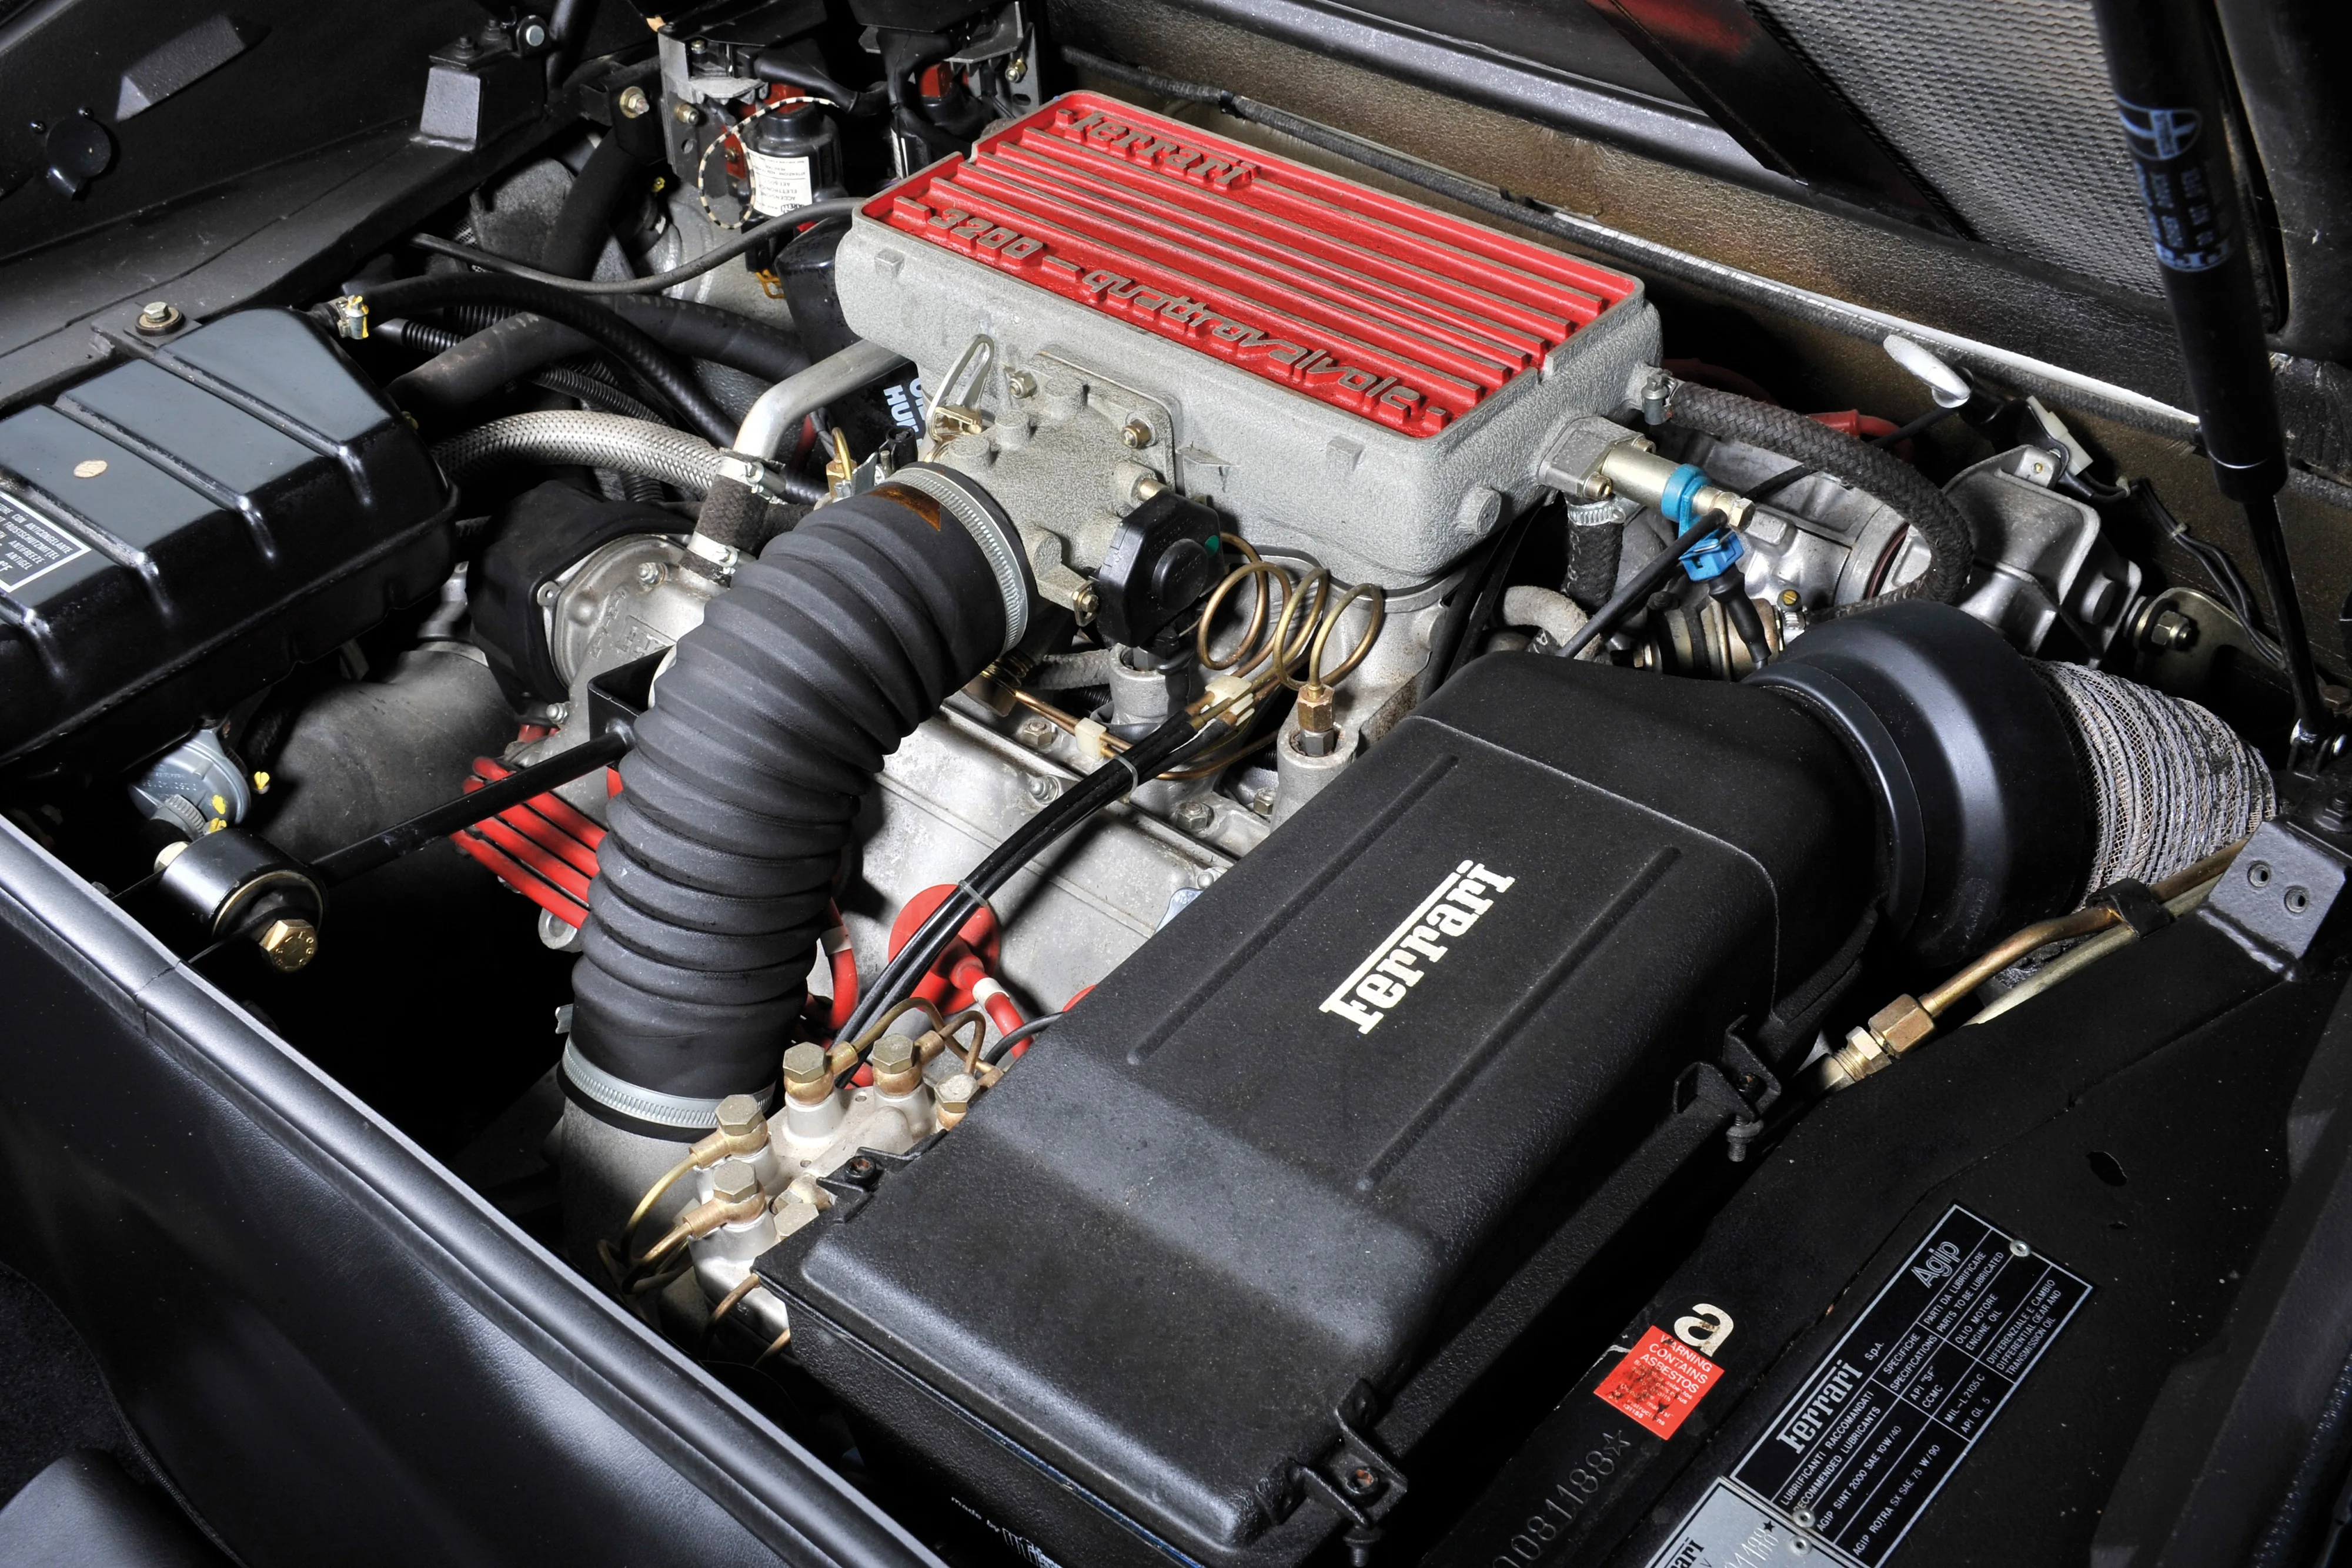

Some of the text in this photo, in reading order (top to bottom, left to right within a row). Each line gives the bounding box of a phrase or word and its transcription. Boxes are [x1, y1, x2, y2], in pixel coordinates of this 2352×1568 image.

[1067, 110, 1257, 185] Ferrari
[927, 208, 1421, 410] 3200 quattrovalvole
[5, 551, 33, 570] ANTIGEL
[8, 540, 45, 564] ANTIFREEZE
[1318, 860, 1516, 1035] Ferrari
[1923, 1252, 1986, 1325] PARTI DA LUBRIFICARE
[1936, 1252, 2004, 1332] PARTS TO BE LUBRICATED
[1955, 1293, 1997, 1344] OLIO MOTORE
[1966, 1310, 2002, 1350] ENGINE OIL
[1986, 1314, 2029, 1364] DIFFERENZIALE
[2031, 1279, 2055, 1306] CAMBIO
[1996, 1290, 2061, 1370] DIFFERENTIAL GEAR AND
[1640, 1353, 1699, 1394] ASBESTOS
[1649, 1343, 1708, 1385] CONTAINS
[1659, 1334, 1713, 1373] WARNING
[1776, 1359, 1863, 1455] Ferrari
[1911, 1241, 1960, 1288] Agip
[1883, 1333, 1920, 1375] SPECIFICHE
[1886, 1335, 1937, 1395] SPECIFICATIONS
[2005, 1318, 2056, 1375] TRANSMISSION OIL
[1664, 1379, 1693, 1400] asbetos
[1910, 1385, 1925, 1400] API
[1922, 1385, 1943, 1407] CCMC
[1840, 1406, 1881, 1454] LUBRICANTS
[1961, 1419, 1974, 1433] API
[1971, 1407, 1983, 1417] GL
[1780, 1390, 1874, 1506] LUBRIFICANTI RACCOMANDATI
[1816, 1510, 1833, 1532] AGIP
[1833, 1489, 1852, 1509] SINT
[1849, 1469, 1867, 1490] 2000
[1863, 1453, 1880, 1470] SAE
[1853, 1534, 1869, 1556] AGIP
[1869, 1507, 1893, 1533] ROTRA
[1890, 1495, 1902, 1505] SX
[1899, 1480, 1914, 1495] SAE
[1912, 1469, 1922, 1479] 75
